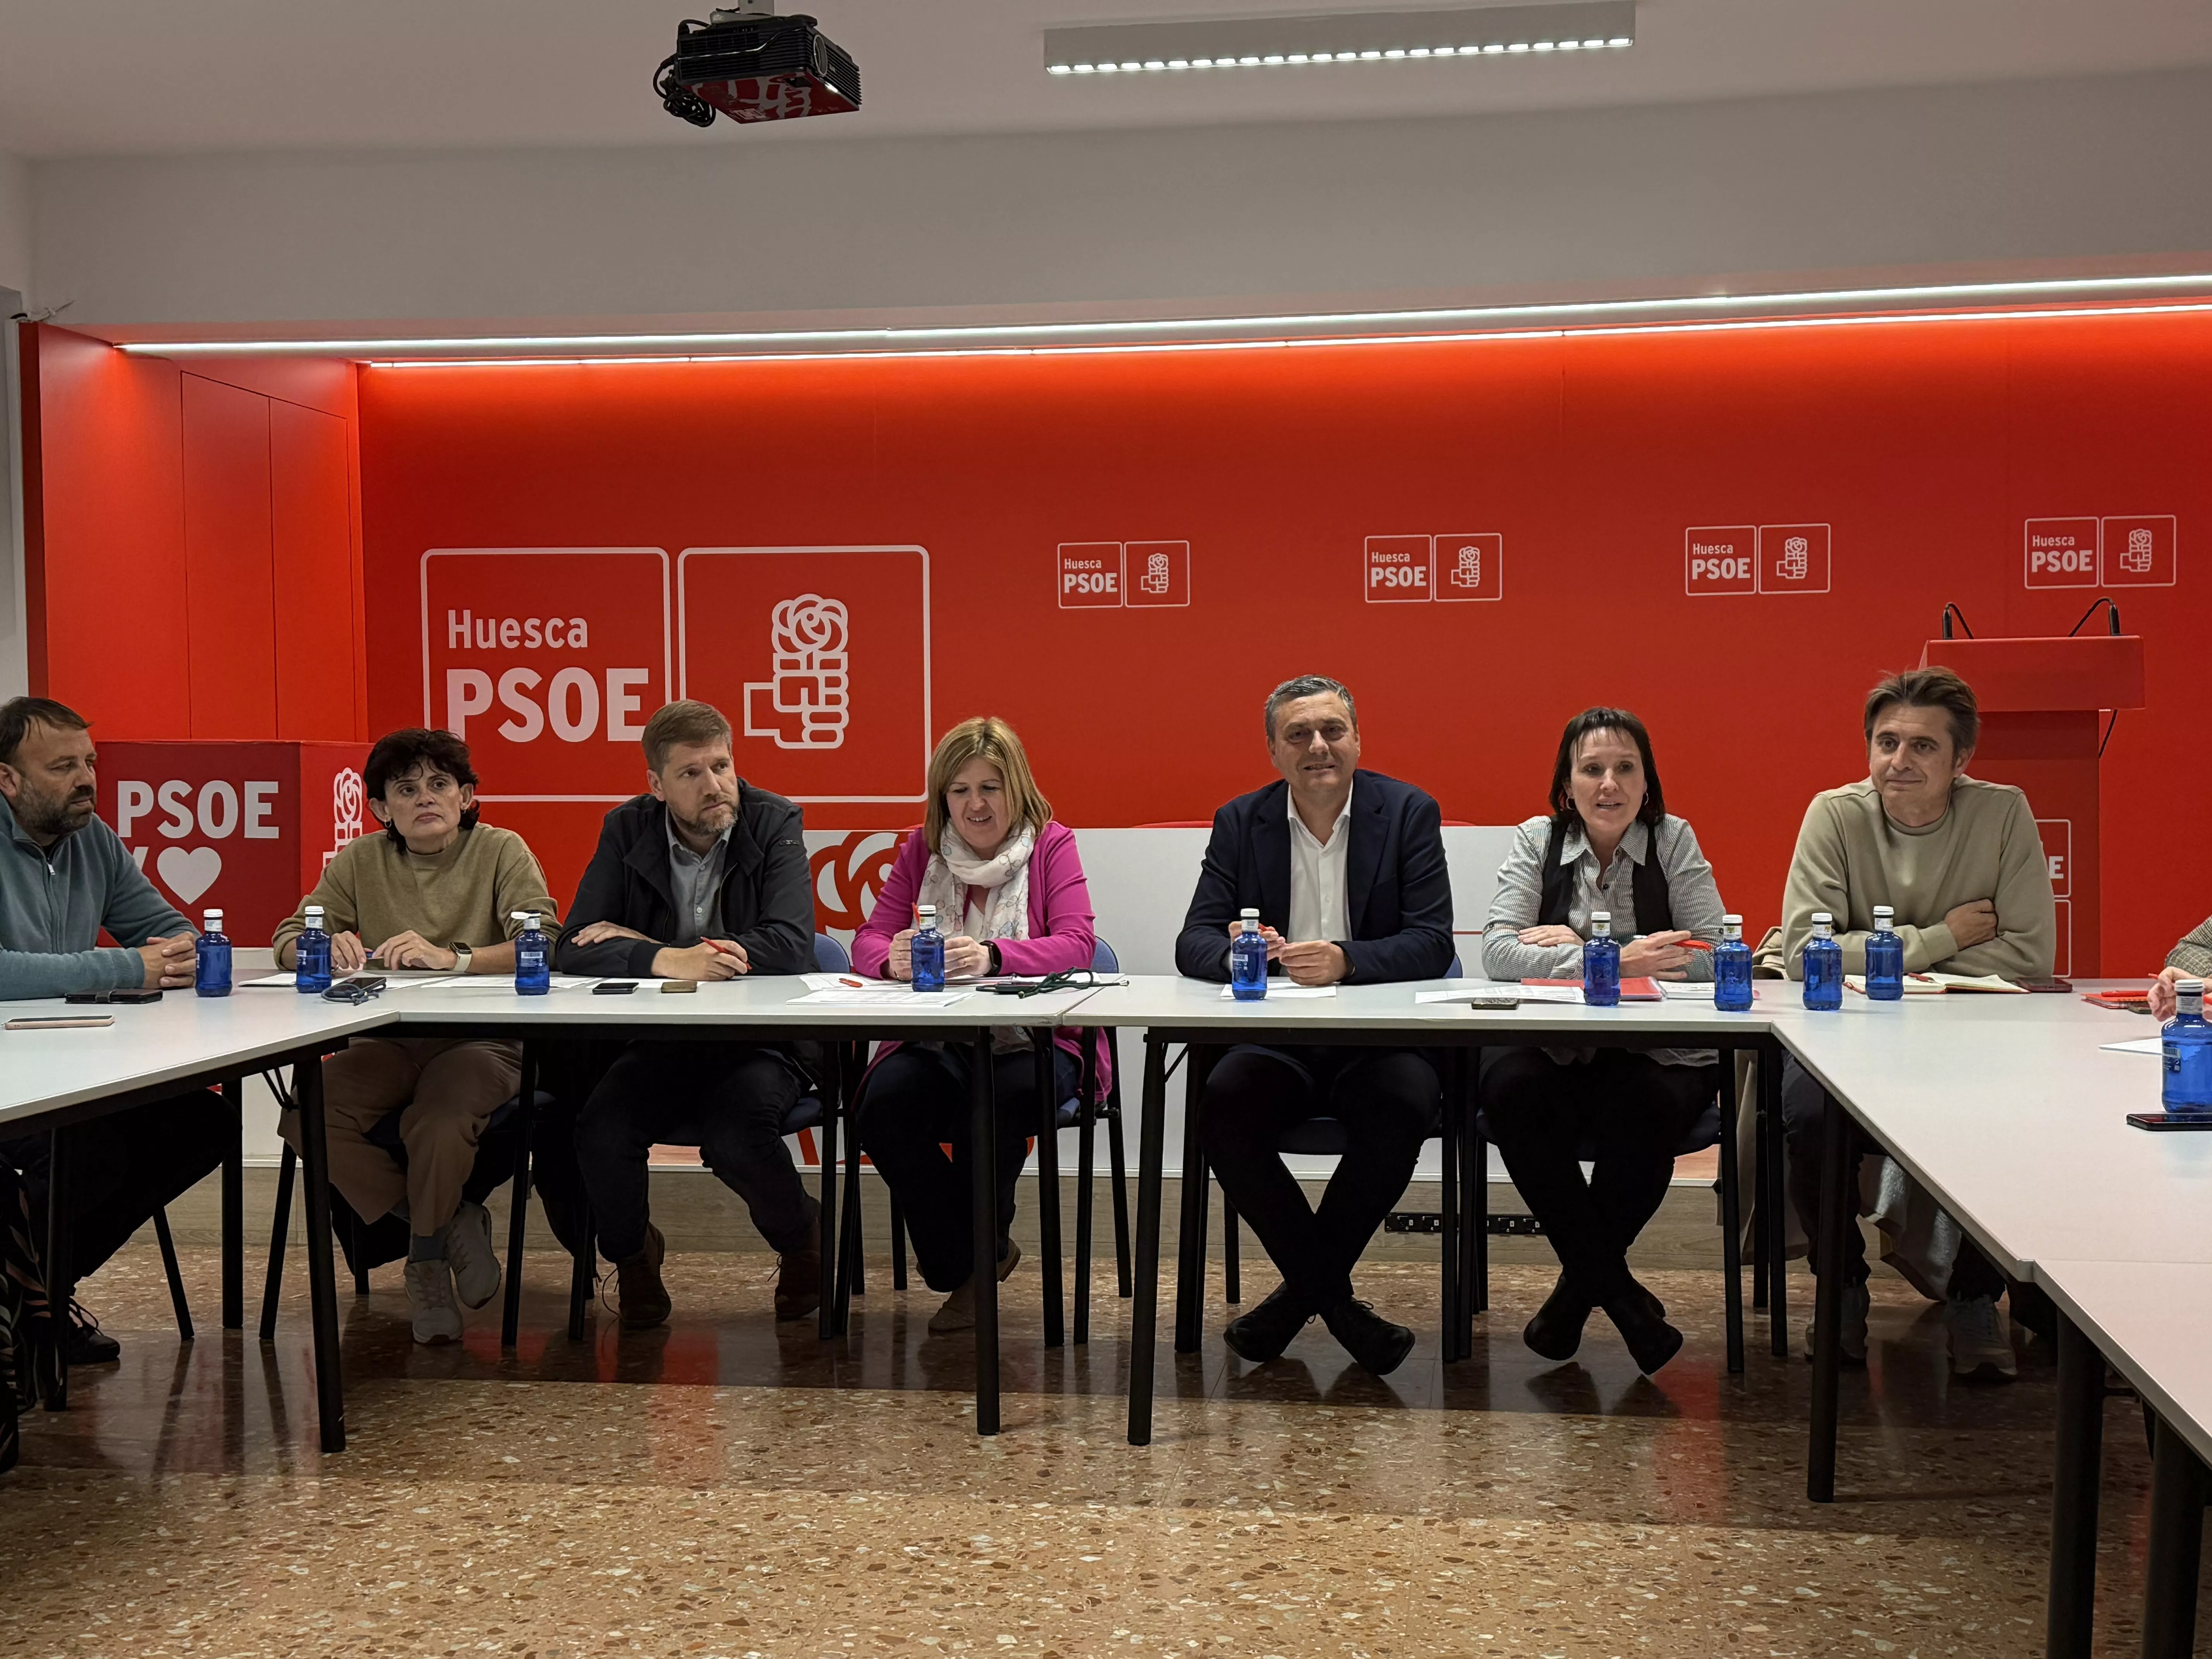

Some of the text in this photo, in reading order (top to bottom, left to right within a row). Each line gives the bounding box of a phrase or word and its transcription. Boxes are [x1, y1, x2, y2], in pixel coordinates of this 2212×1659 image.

[1693, 543, 1733, 555] Huesca
[2032, 535, 2075, 547] Huesca
[1064, 558, 1102, 569] Huesca
[1372, 552, 1410, 563] Huesca
[2032, 550, 2093, 572] PSOE
[1371, 566, 1427, 587] PSOE
[1692, 558, 1750, 580] PSOE
[1064, 572, 1118, 593] PSOE
[448, 610, 588, 649] Huesca
[447, 667, 649, 742] PSOE
[117, 780, 279, 839] PSOE
